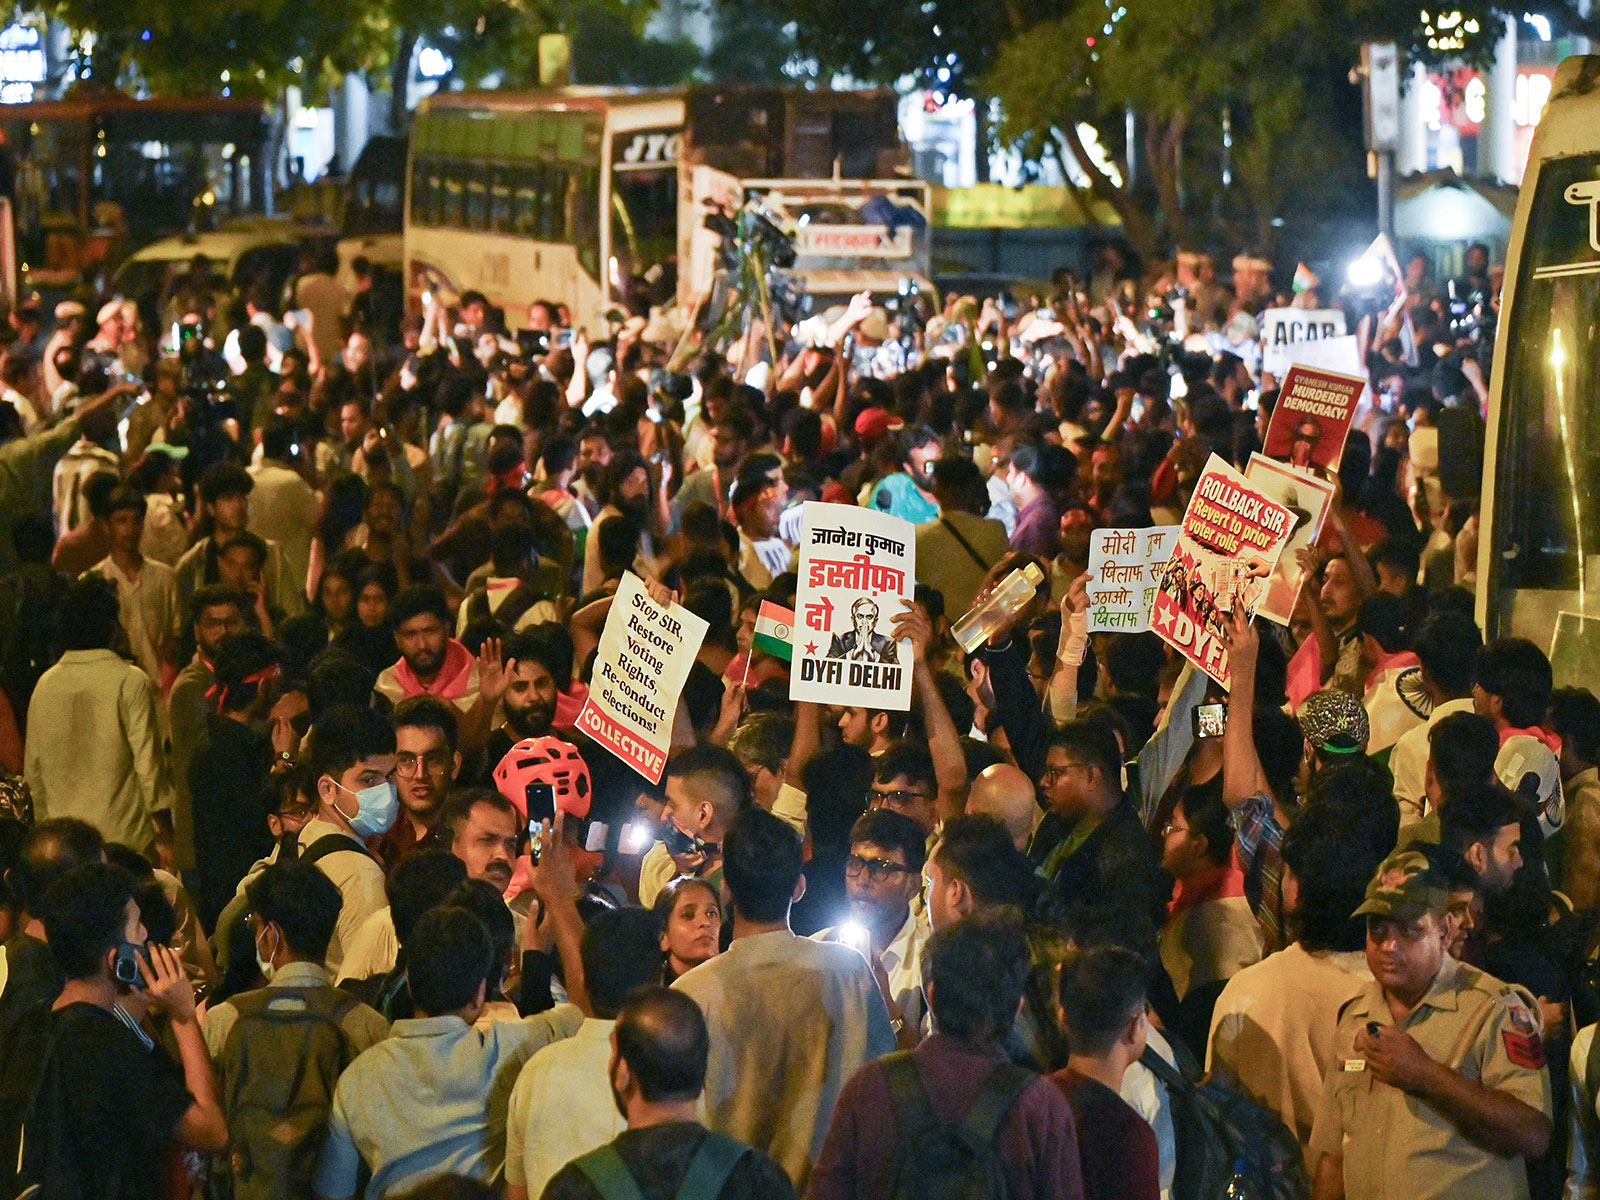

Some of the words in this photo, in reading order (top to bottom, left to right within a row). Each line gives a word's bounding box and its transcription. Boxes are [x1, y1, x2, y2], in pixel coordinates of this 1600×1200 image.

[1291, 384, 1349, 406] MURDERED
[1294, 374, 1328, 388] GYANESH
[1327, 382, 1355, 394] KUMAR
[1283, 396, 1348, 420] DEMOCRACY!
[1194, 498, 1230, 528] Revert
[1230, 516, 1242, 536] to
[1241, 524, 1271, 548] prior
[1200, 476, 1264, 523] ROLLBACK
[1260, 506, 1286, 540] SIR,
[812, 526, 862, 548] ज्ञानेश
[865, 534, 905, 557] कुमार
[1102, 530, 1136, 554] मोदी
[1188, 518, 1216, 542] voter
[1214, 533, 1239, 554] rolls
[632, 593, 658, 621] Stop
[659, 614, 684, 642] SIR,
[805, 596, 834, 632] दो
[628, 614, 674, 655] Restore
[1173, 611, 1228, 672] DYFI
[618, 653, 658, 695] Rights,
[627, 636, 664, 675] Voting
[801, 658, 842, 684] DYFI
[849, 663, 902, 690] DELHI
[602, 662, 666, 722] Re-conduct
[602, 689, 657, 734] elections!
[584, 708, 663, 775] COLLECTIVE
